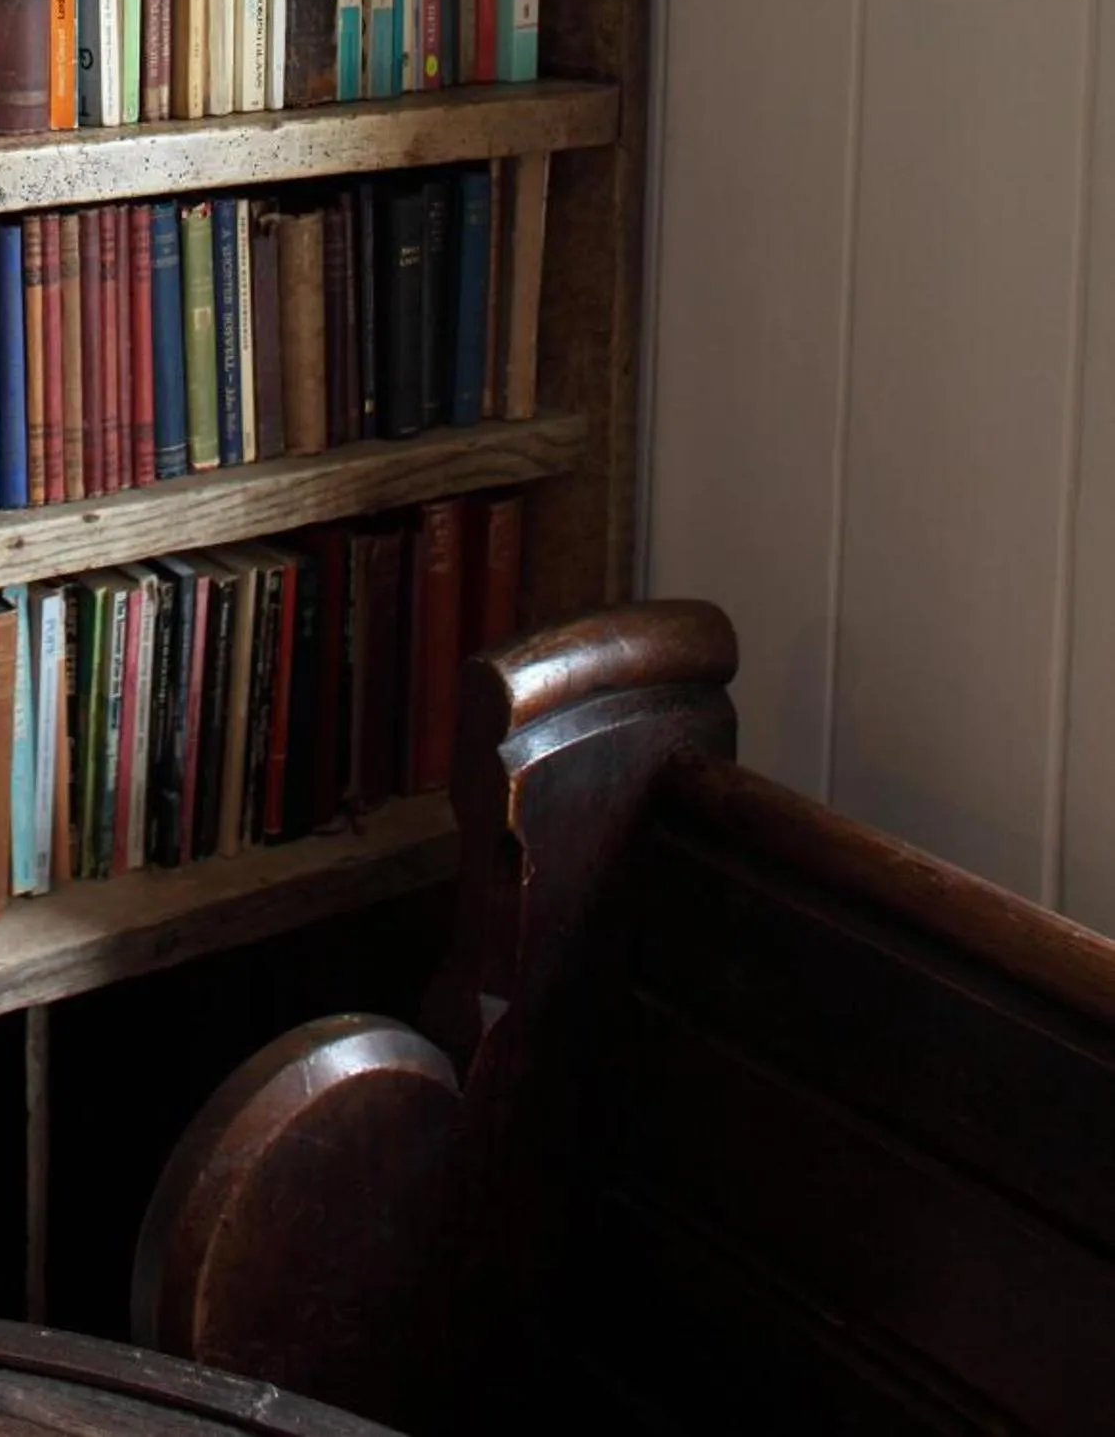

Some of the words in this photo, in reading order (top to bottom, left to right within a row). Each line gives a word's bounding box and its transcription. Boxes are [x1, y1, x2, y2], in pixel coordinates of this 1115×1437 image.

[221, 228, 231, 239] A
[222, 245, 233, 304] SHORTER
[223, 312, 235, 371] BOSWELL
